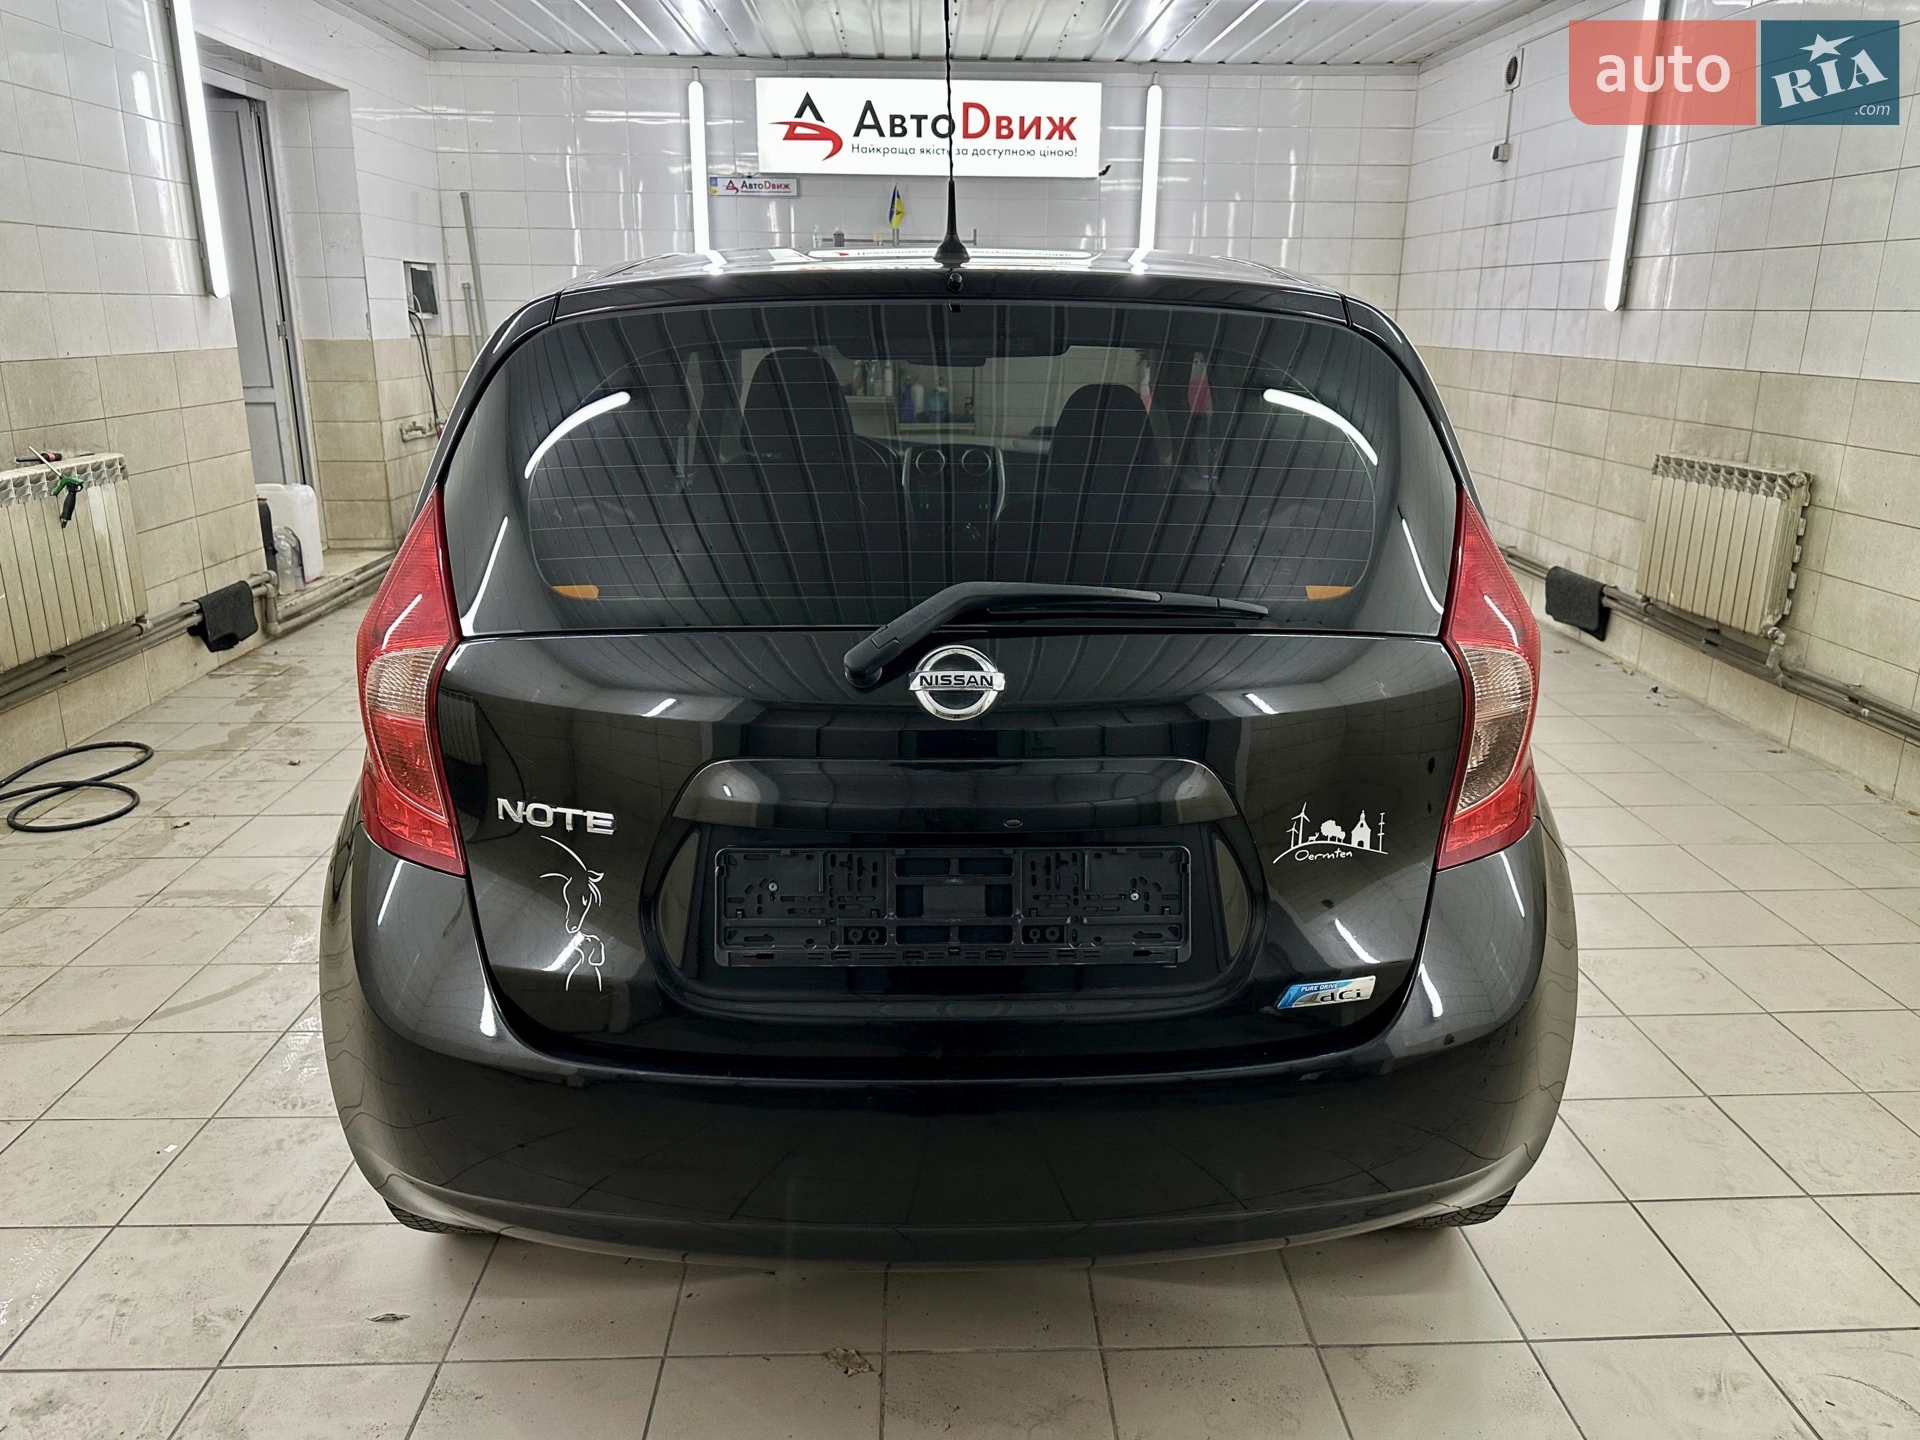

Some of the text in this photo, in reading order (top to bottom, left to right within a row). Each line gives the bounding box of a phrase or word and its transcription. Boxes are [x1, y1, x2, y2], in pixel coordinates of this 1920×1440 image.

[851, 143, 915, 157] Найкраща
[971, 149, 1036, 159] доступною
[1039, 146, 1078, 158] ціною!
[920, 675, 993, 686] NISSAN
[497, 798, 616, 835] NOTE
[1295, 847, 1353, 861] Oermten
